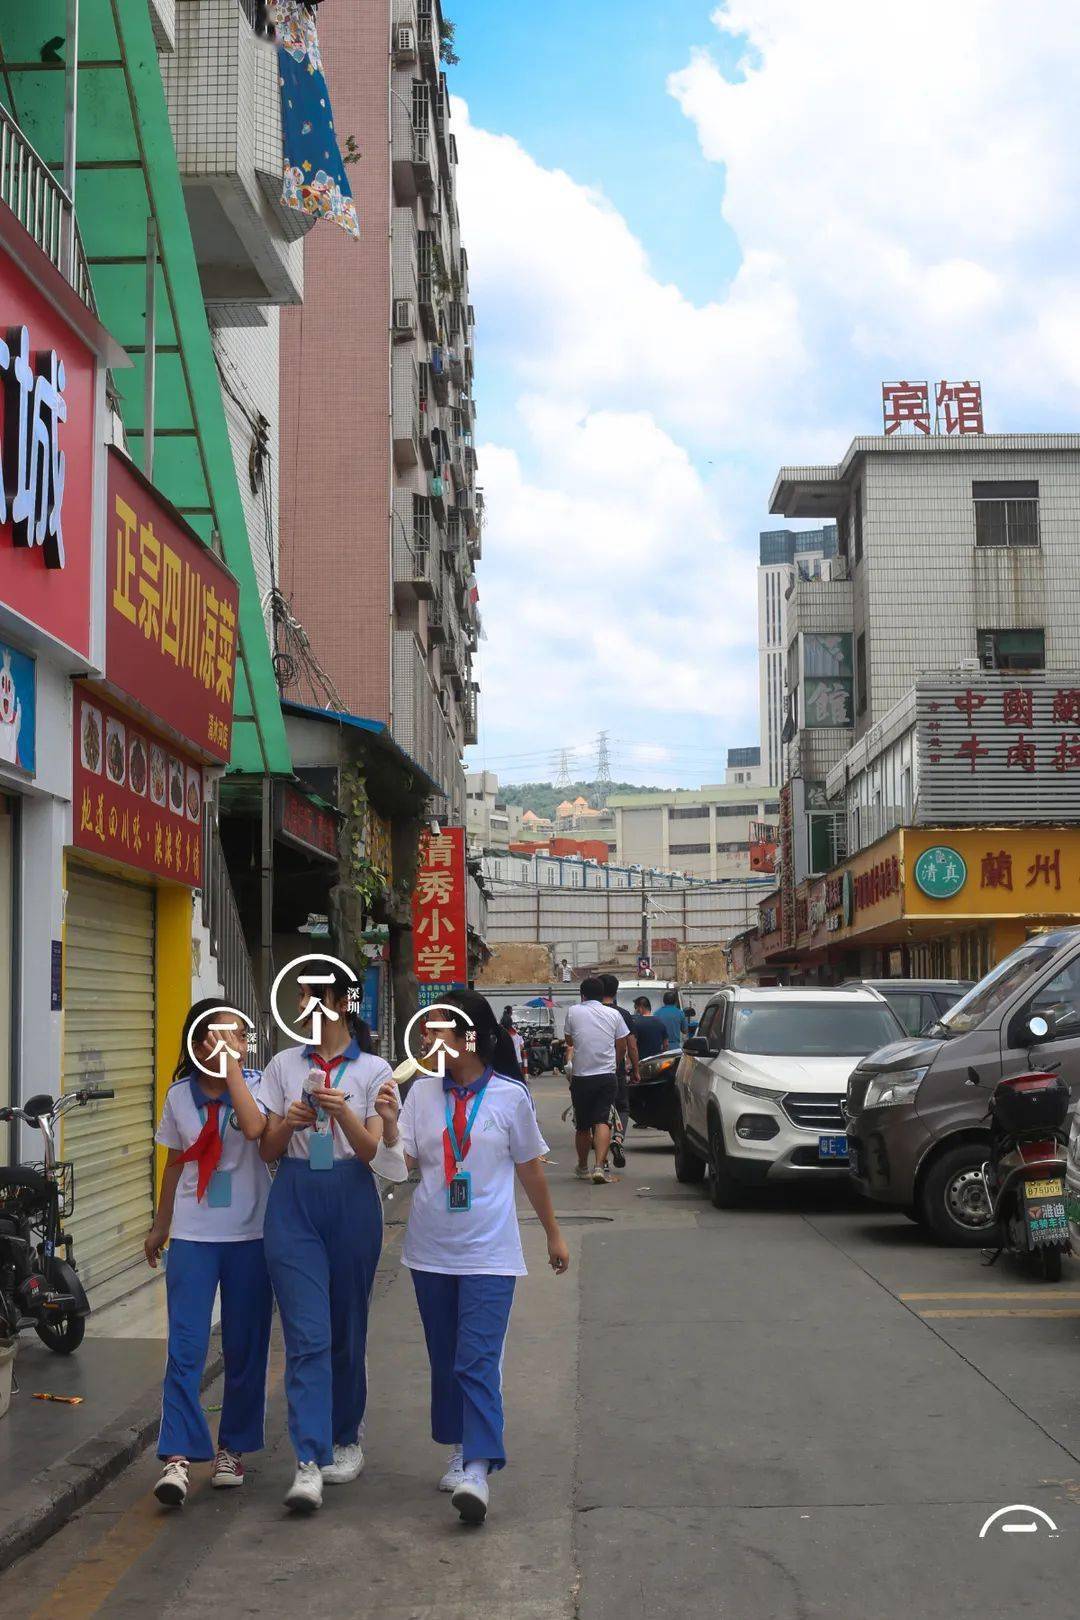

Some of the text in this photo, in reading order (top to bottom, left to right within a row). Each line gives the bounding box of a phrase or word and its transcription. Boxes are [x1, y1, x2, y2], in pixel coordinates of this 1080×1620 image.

[884, 381, 983, 435] 宾馆
[113, 494, 235, 704] 正宗四川凉菜
[922, 861, 960, 884] 清真
[417, 834, 456, 979] 清秀小学
[1041, 1204, 1065, 1218] 雅迪
